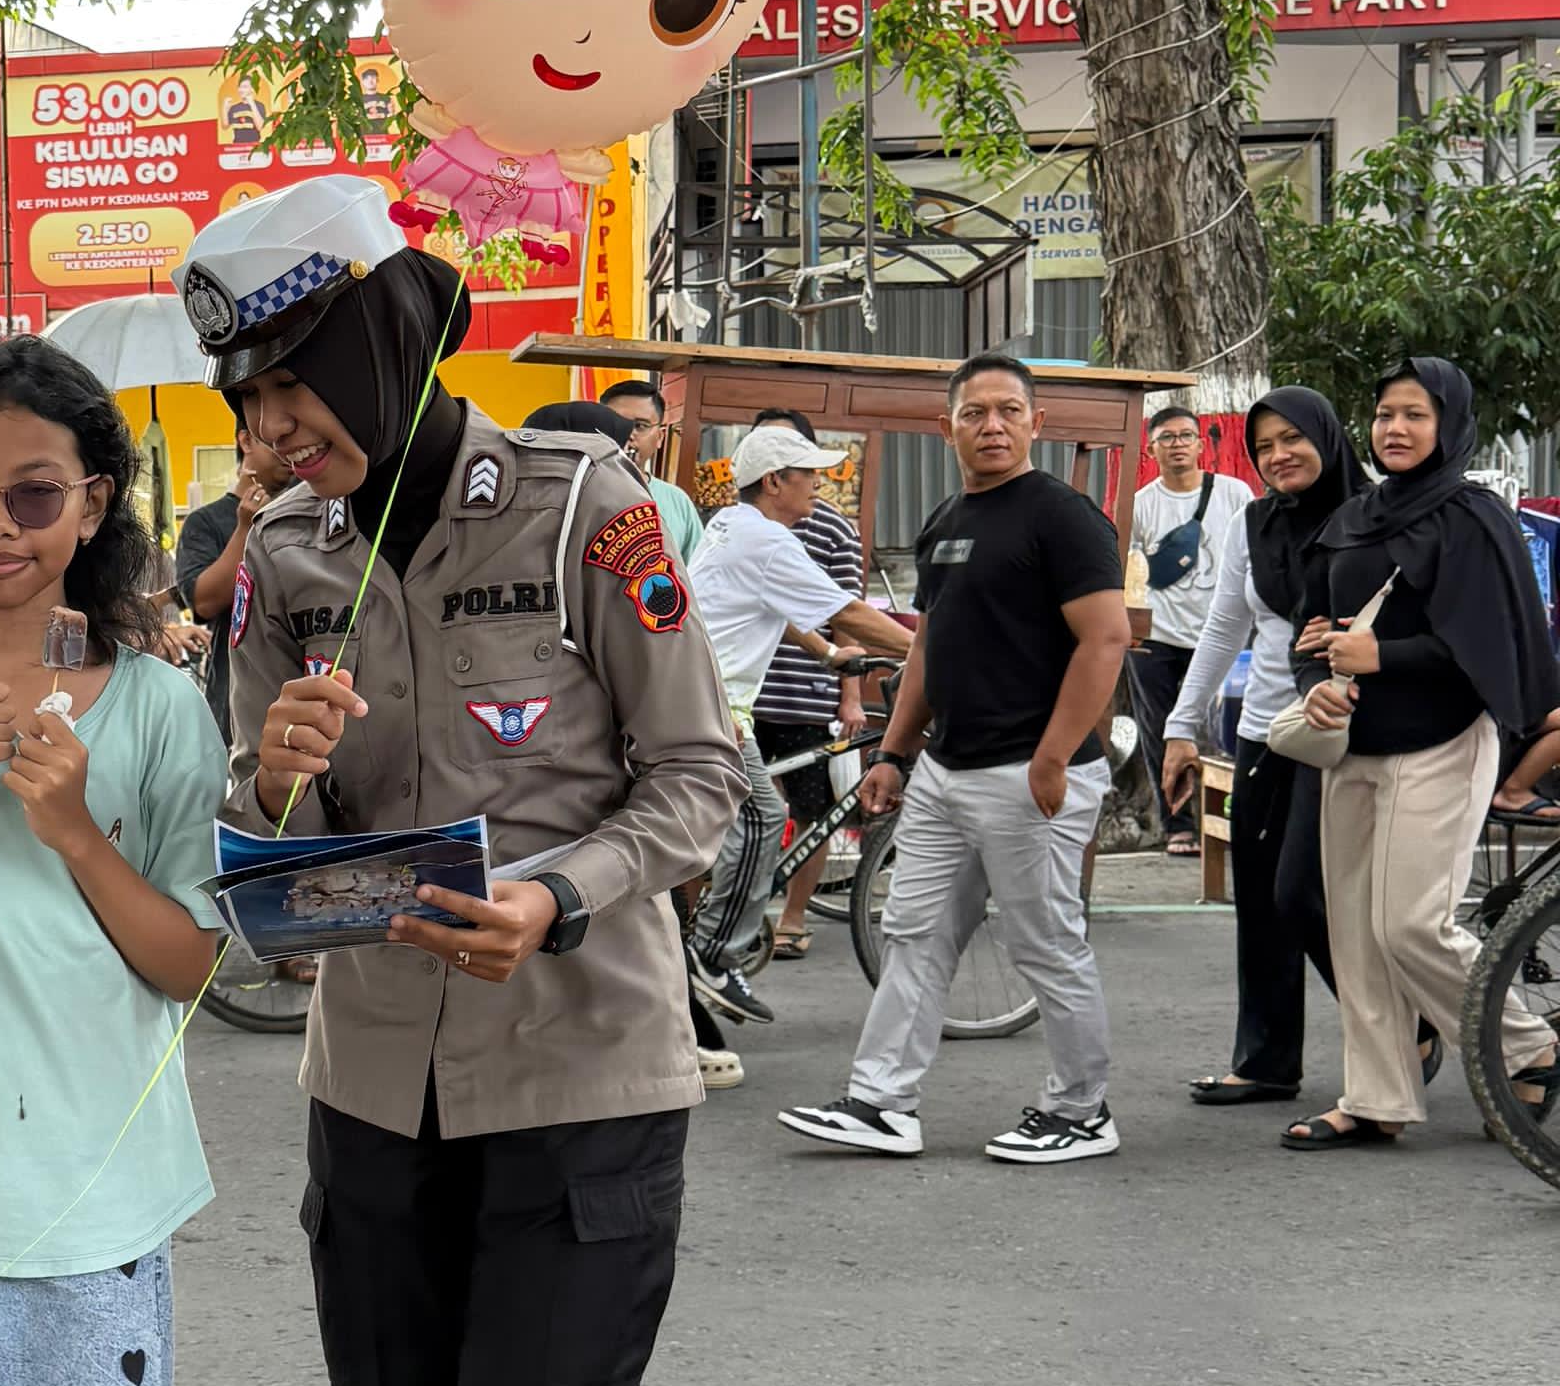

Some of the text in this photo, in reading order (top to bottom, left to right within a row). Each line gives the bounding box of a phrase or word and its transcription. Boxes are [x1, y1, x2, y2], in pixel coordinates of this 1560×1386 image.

[747, 5, 860, 41] ALES
[34, 79, 188, 123] 53.000
[88, 121, 132, 136] LEBIH
[35, 134, 188, 163] KELULUSAN
[45, 162, 178, 189] SISWA GO
[17, 191, 209, 210] KE PTN DAN PT KEDINASAN 2025
[77, 222, 150, 246] 2.550
[593, 506, 653, 554] POLRES
[441, 581, 556, 621] POLRI
